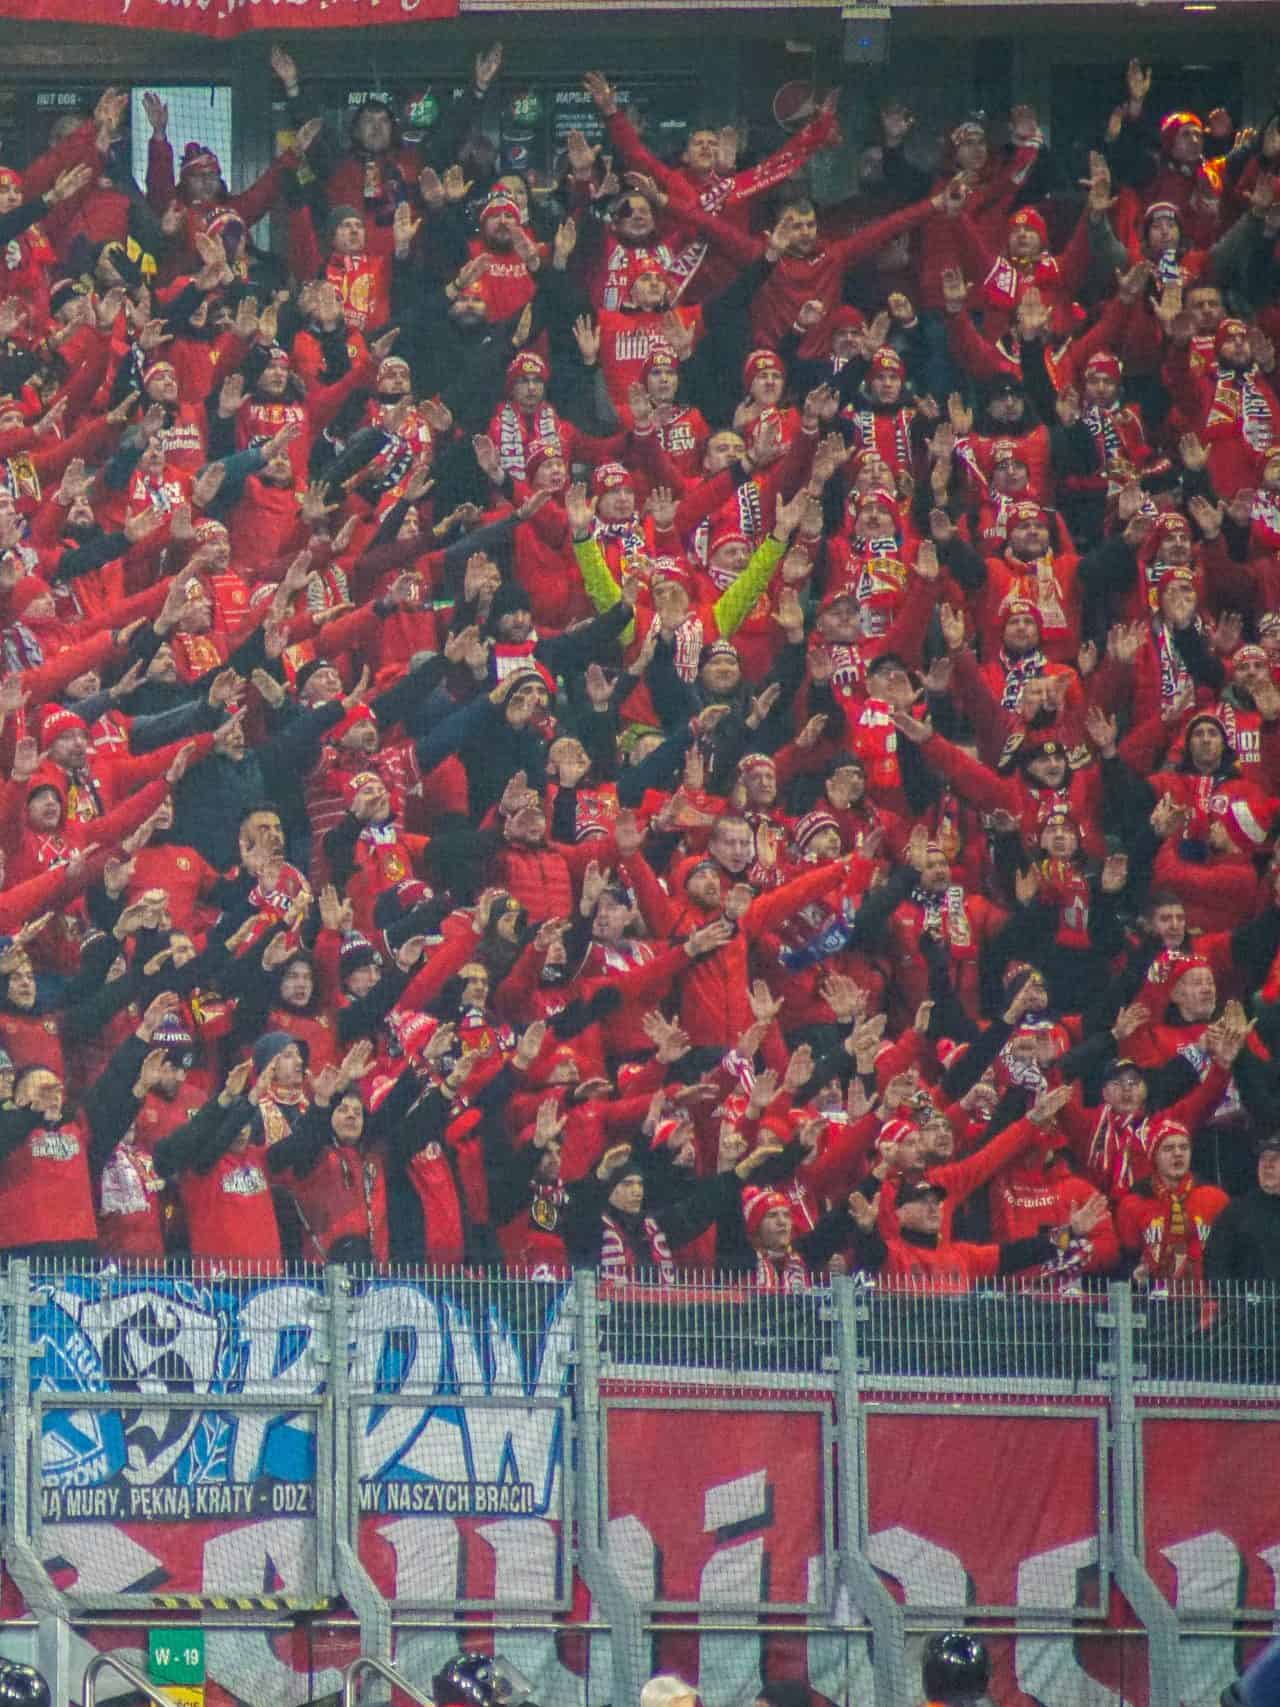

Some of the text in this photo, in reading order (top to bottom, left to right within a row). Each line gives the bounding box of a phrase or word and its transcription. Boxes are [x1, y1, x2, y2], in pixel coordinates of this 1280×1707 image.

[67, 1487, 124, 1517] MURY,
[130, 1485, 190, 1519] PĘKNĄ
[196, 1485, 254, 1513] KRATY
[387, 1485, 470, 1512] NASZYCH
[155, 1647, 170, 1666] W
[183, 1647, 200, 1666] 19
